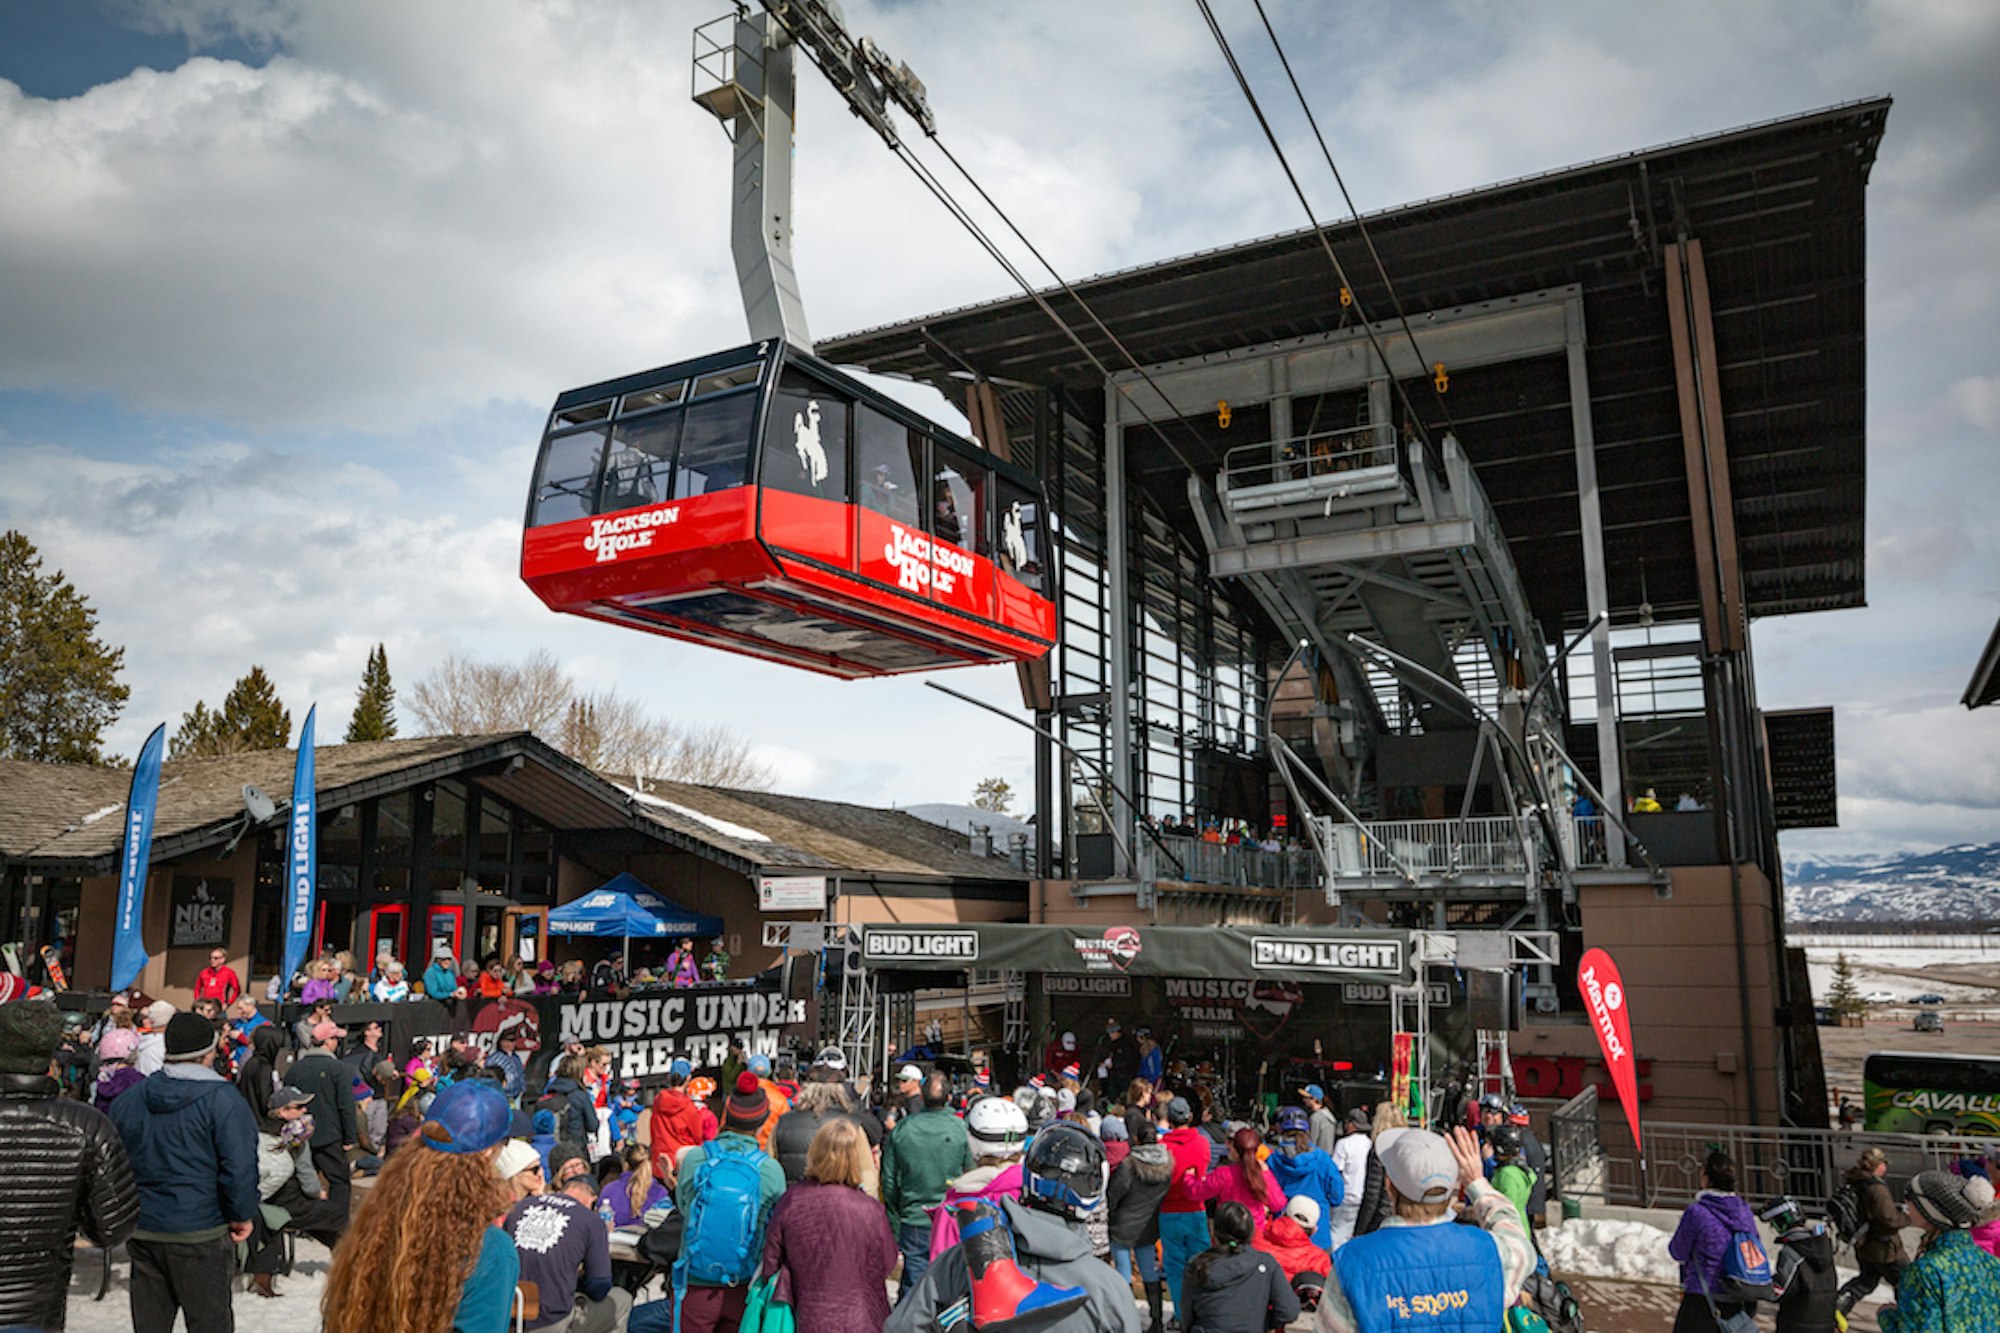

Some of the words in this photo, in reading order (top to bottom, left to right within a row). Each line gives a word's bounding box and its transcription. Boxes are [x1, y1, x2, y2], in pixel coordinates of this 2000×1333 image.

[757, 341, 769, 356] 2
[584, 507, 680, 551] JACKSON
[596, 531, 652, 562] HOLE
[884, 524, 975, 578] JACKSON
[898, 557, 954, 594] HOLE
[294, 800, 310, 875] LIGHT
[175, 904, 226, 922] NICK
[293, 877, 310, 932] BUD
[869, 935, 911, 954] BUD
[912, 935, 974, 955] LIGHT
[1074, 938, 1115, 950] MUSIC
[1256, 942, 1313, 964] BUD
[1315, 944, 1397, 968] LIGHT
[1047, 976, 1080, 992] BUD
[1080, 978, 1127, 993] LIGHT
[1165, 979, 1248, 999] MUSIC
[1345, 984, 1387, 1000] BUD
[559, 998, 684, 1042] MUSIC
[696, 993, 806, 1030] UNDER
[1180, 1006, 1235, 1021] TRAM
[1582, 966, 1626, 1061] Marmot
[1891, 1091, 2000, 1113] CAVALL
